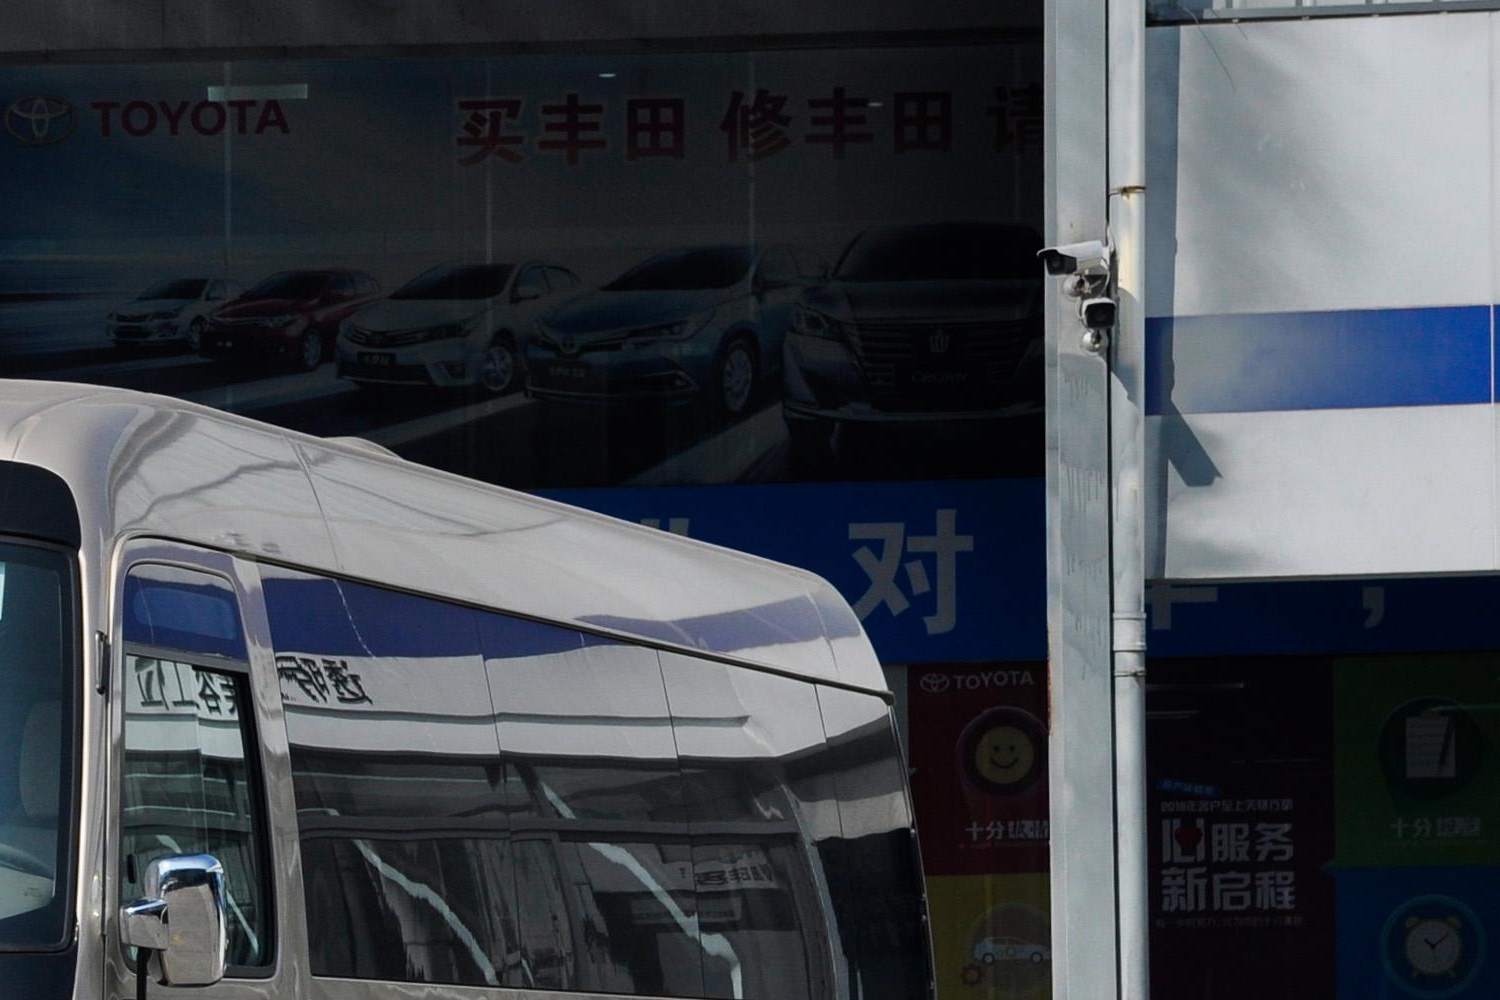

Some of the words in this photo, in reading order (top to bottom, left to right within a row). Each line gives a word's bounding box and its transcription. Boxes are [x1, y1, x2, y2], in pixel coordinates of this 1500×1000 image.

[91, 99, 291, 138] TOYOTA
[848, 508, 975, 635] 对
[953, 670, 1035, 690] TOYOTA
[1160, 865, 1296, 913] 新启程
